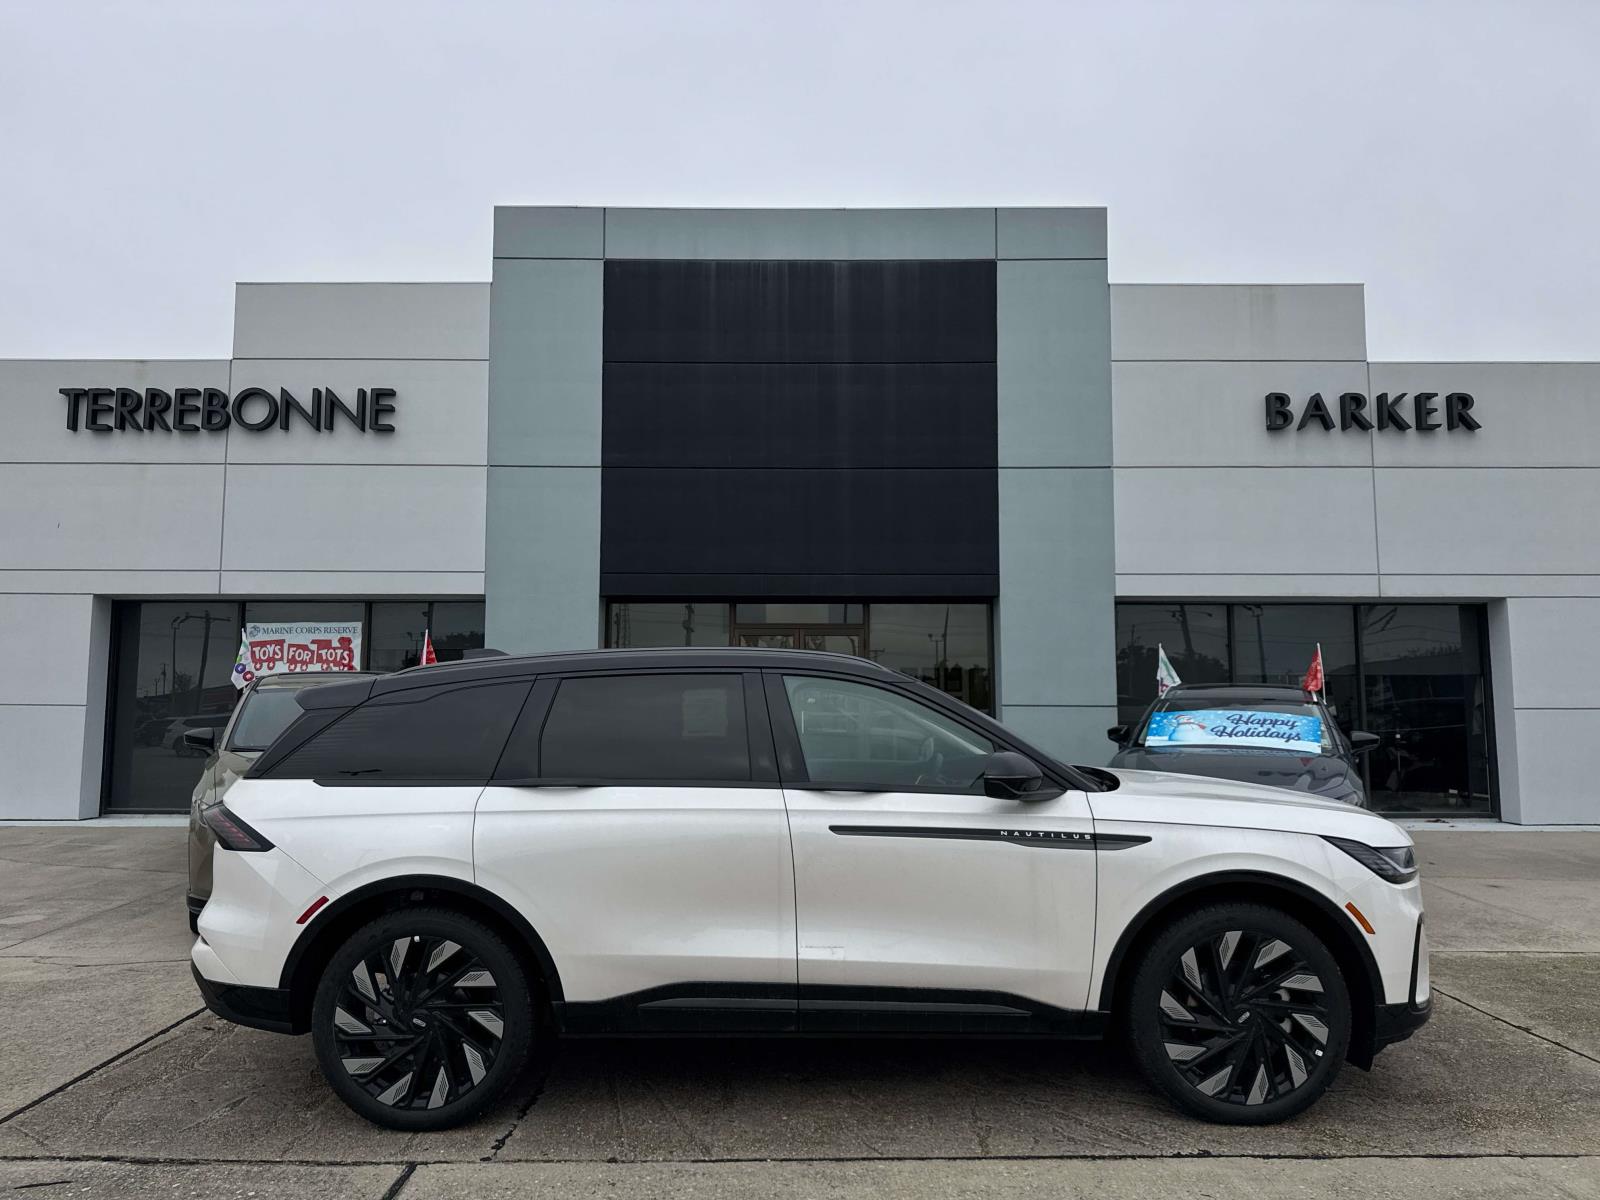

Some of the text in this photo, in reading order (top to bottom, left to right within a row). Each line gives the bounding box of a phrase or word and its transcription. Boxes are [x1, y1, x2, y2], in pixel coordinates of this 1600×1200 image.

[59, 387, 396, 432] TERREBONNE
[1265, 392, 1482, 431] BARKER
[262, 626, 358, 635] MARINE CORPS RESERVE
[252, 643, 350, 664] TOYS FOR TOTS
[1226, 713, 1298, 730] Happy
[1210, 725, 1301, 742] Holidays
[1000, 830, 1092, 840] NAUTILUS
